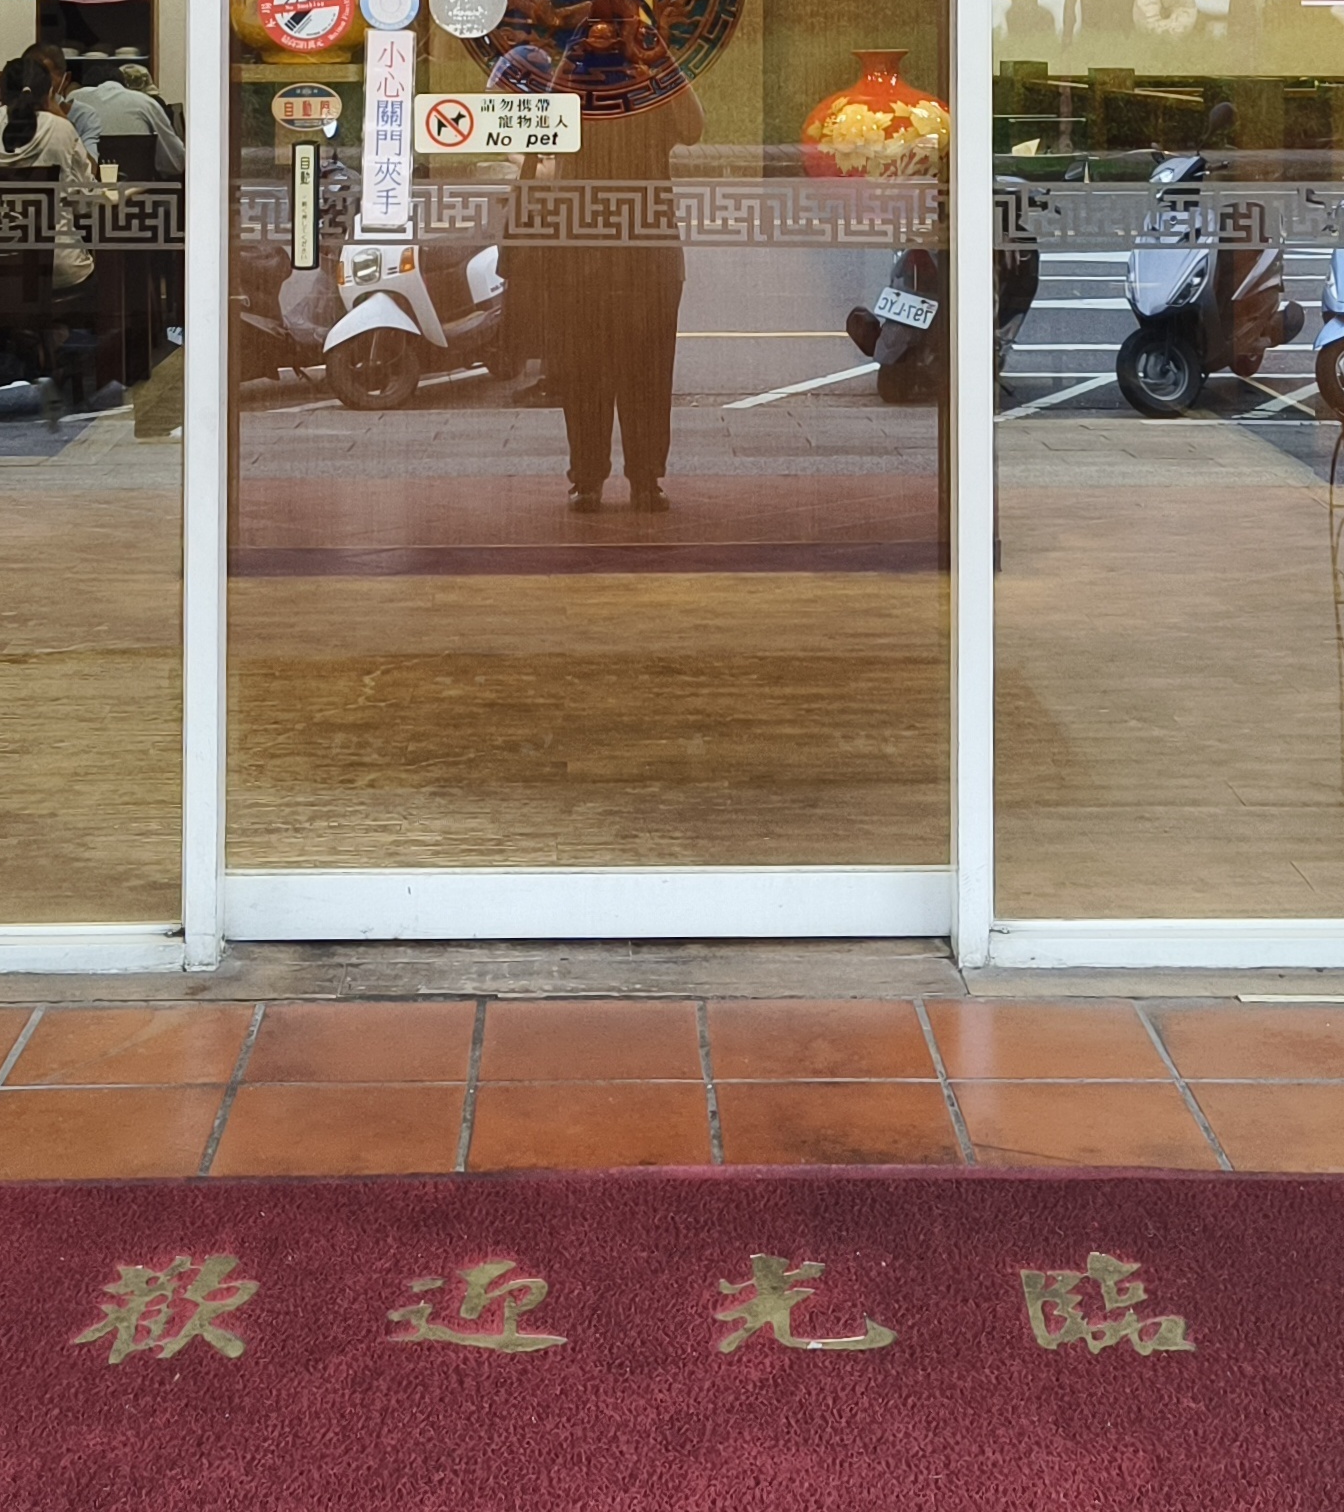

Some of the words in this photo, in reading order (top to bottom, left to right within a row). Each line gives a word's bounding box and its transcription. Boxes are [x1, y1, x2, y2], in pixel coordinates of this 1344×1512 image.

[371, 40, 407, 217] 小心關門夾手
[485, 131, 513, 147] No
[526, 131, 559, 149] pet
[69, 1252, 1197, 1364] 歡迎光臨
